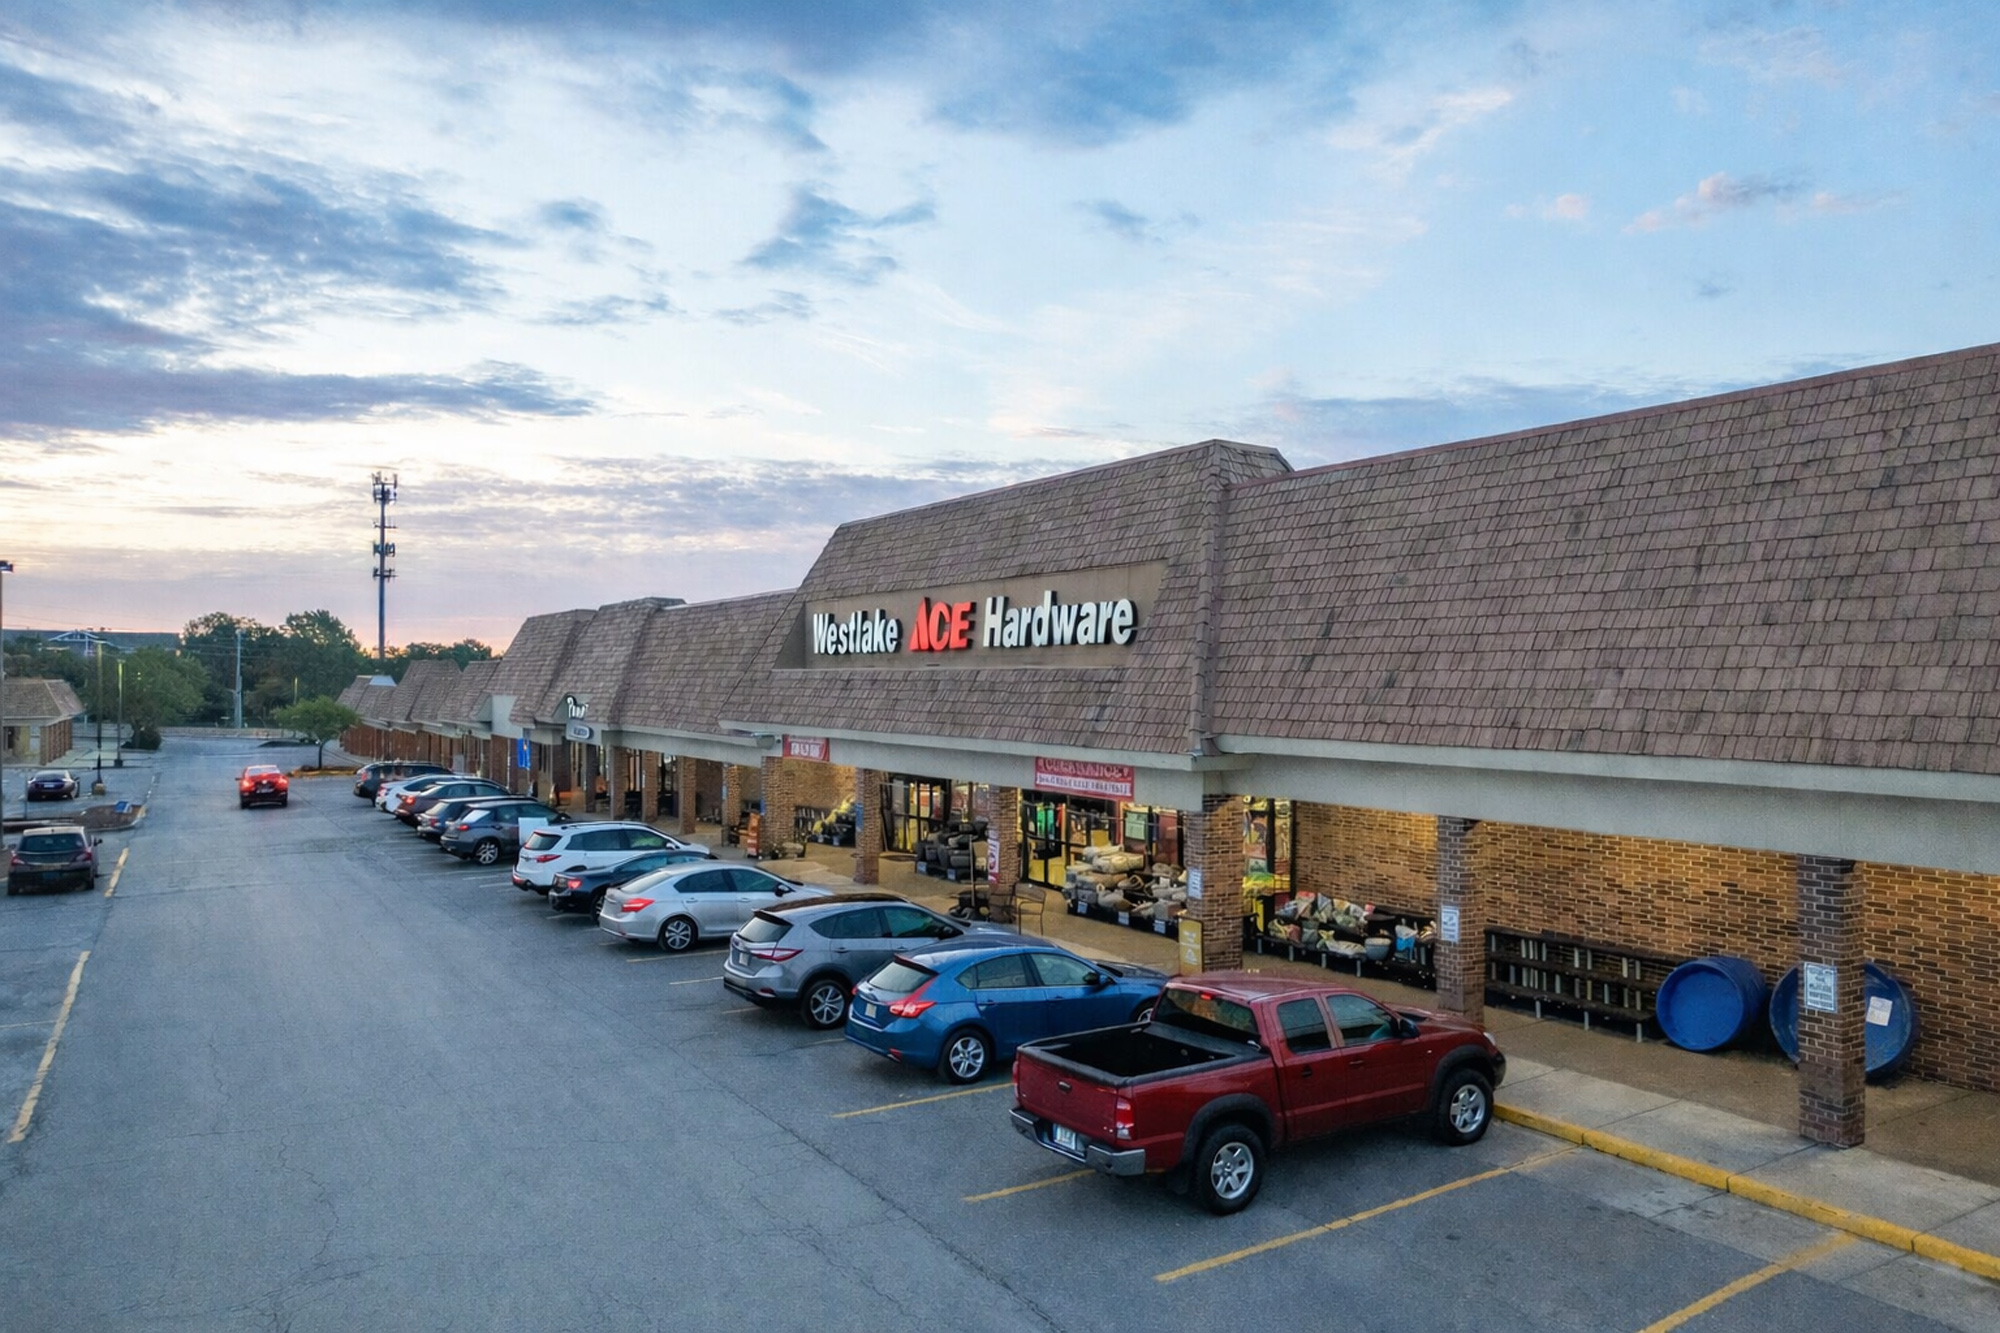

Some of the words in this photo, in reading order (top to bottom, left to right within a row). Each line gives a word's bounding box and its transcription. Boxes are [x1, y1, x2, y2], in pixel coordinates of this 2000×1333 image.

[813, 608, 900, 655] Westlake
[909, 598, 973, 652] ACE
[983, 590, 1134, 648] Hardware
